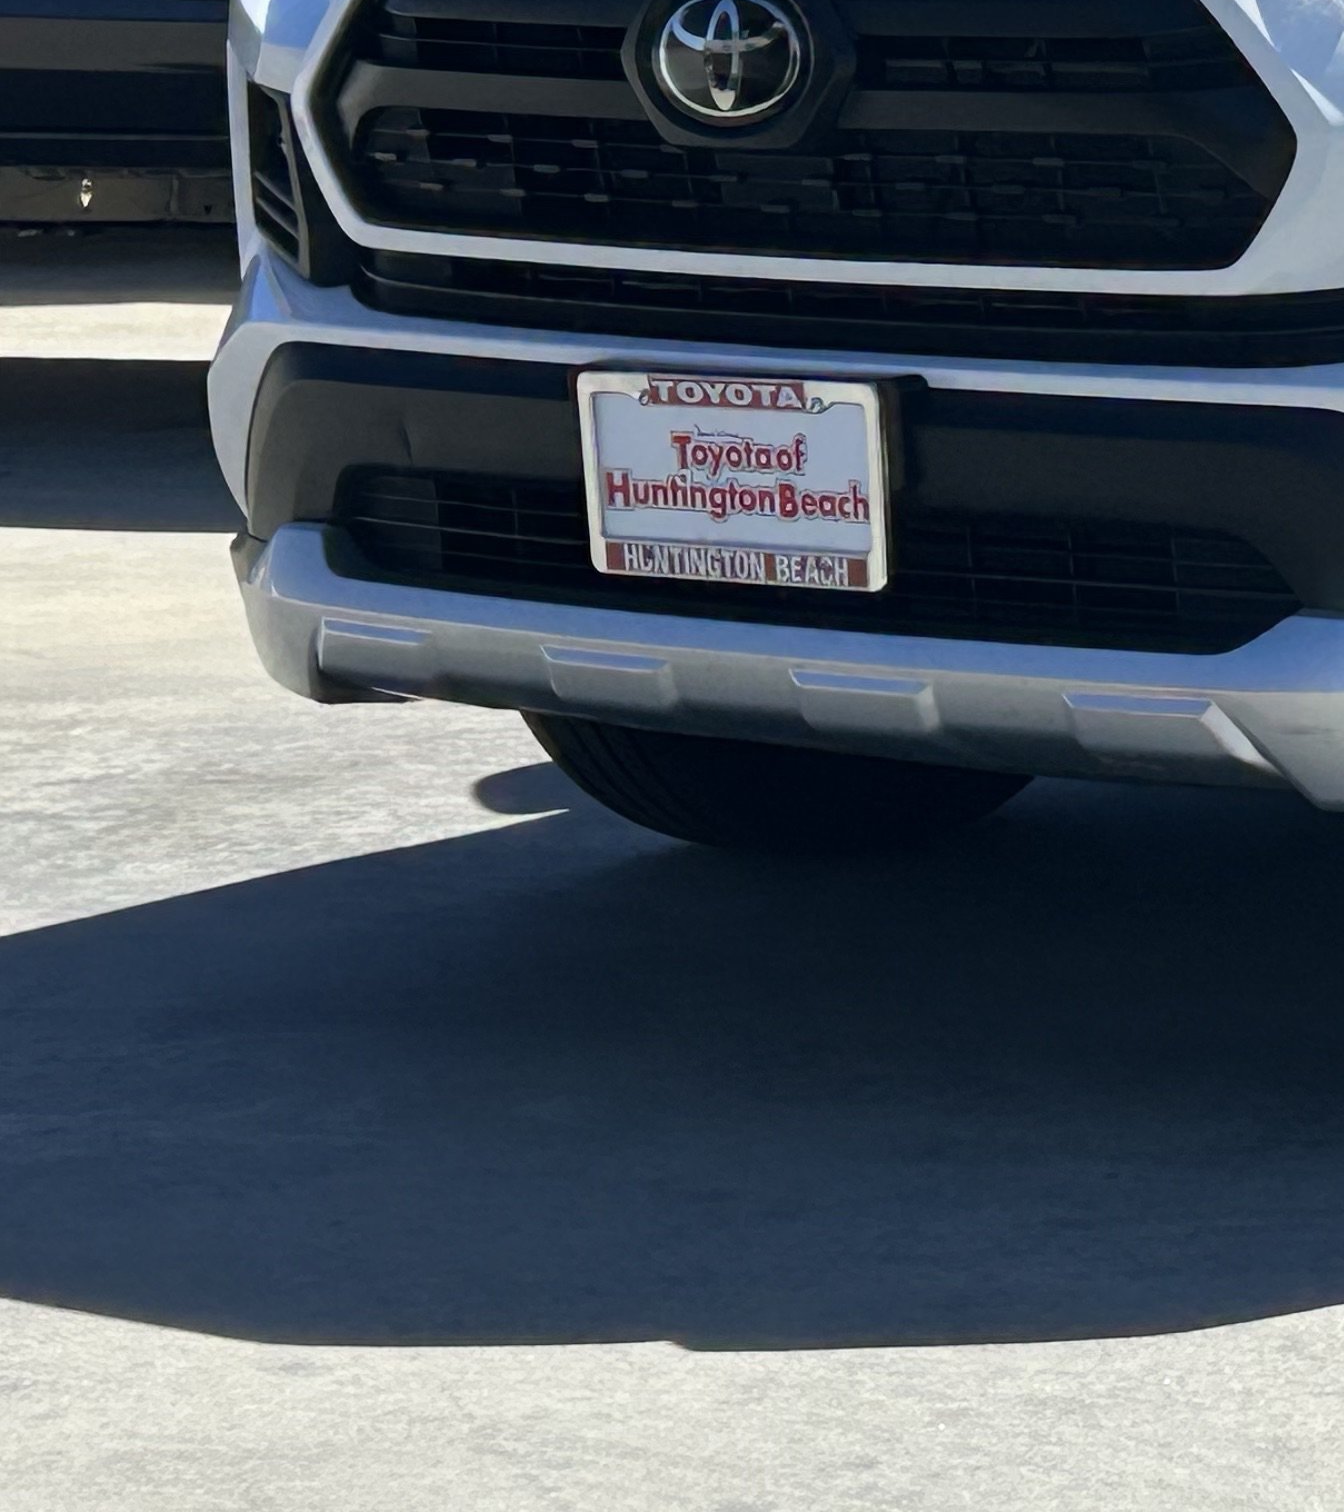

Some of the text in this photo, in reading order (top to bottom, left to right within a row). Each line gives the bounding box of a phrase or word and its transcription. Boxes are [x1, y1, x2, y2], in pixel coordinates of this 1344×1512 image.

[650, 379, 803, 410] TOYOTA
[670, 432, 807, 478] Toyota of
[605, 471, 870, 521] Huntington Beach
[623, 542, 849, 587] HUNTINGTON BEACH
